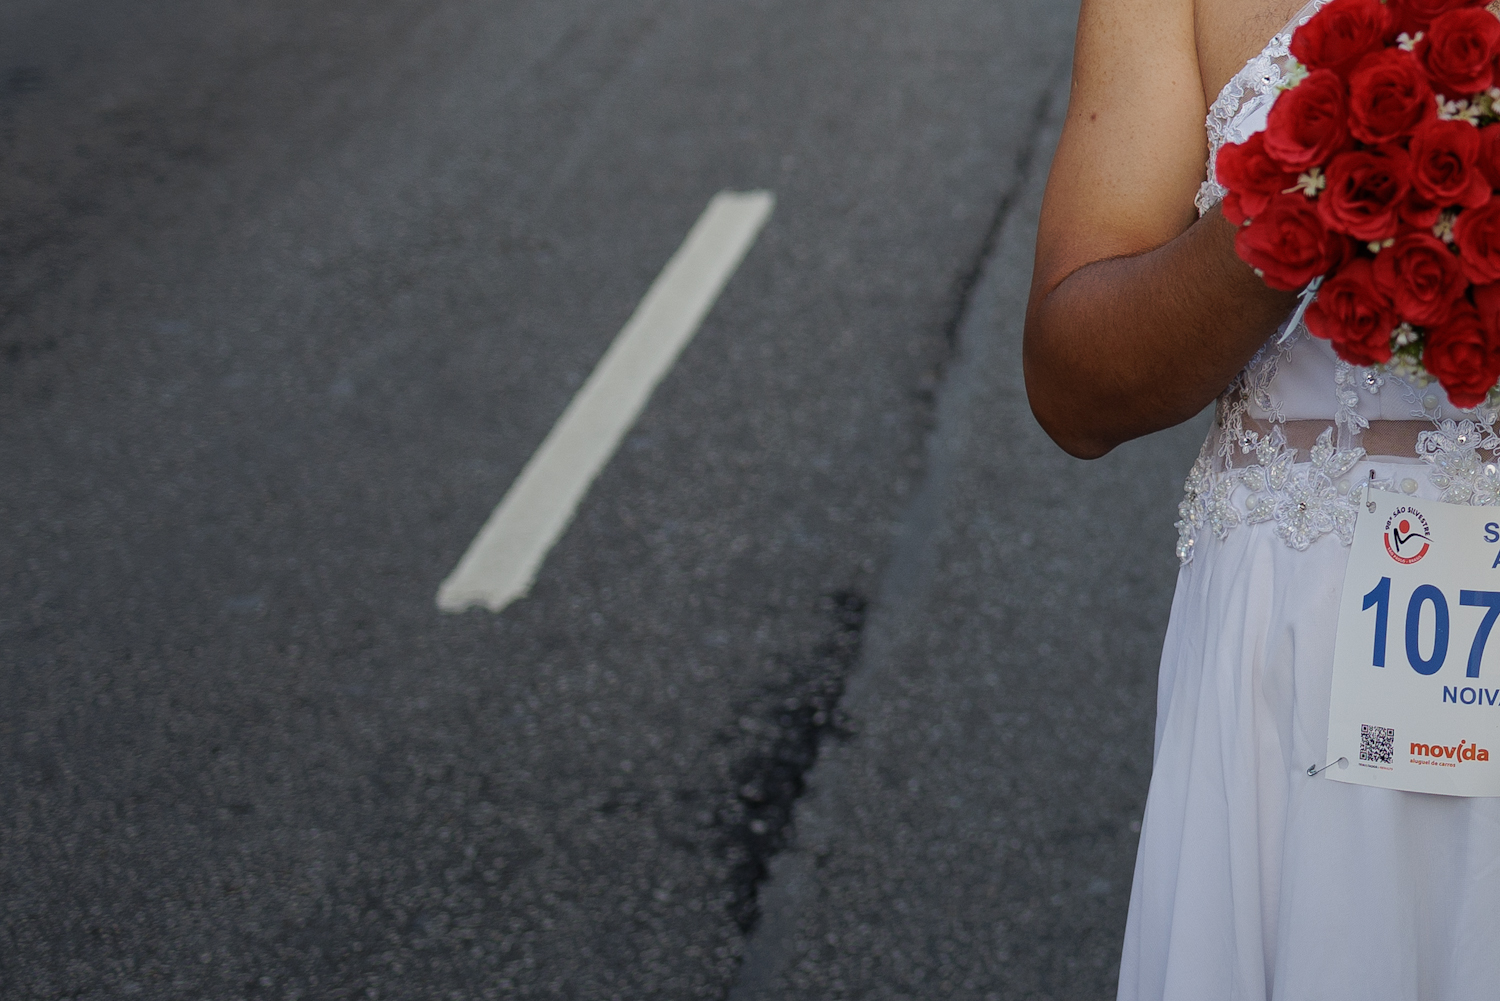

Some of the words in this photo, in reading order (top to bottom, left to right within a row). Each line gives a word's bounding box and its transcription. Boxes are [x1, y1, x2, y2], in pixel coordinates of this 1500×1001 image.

[1407, 506, 1431, 536] SILVESTRE
[1410, 739, 1490, 763] movida
[1410, 758, 1431, 766] aluguel
